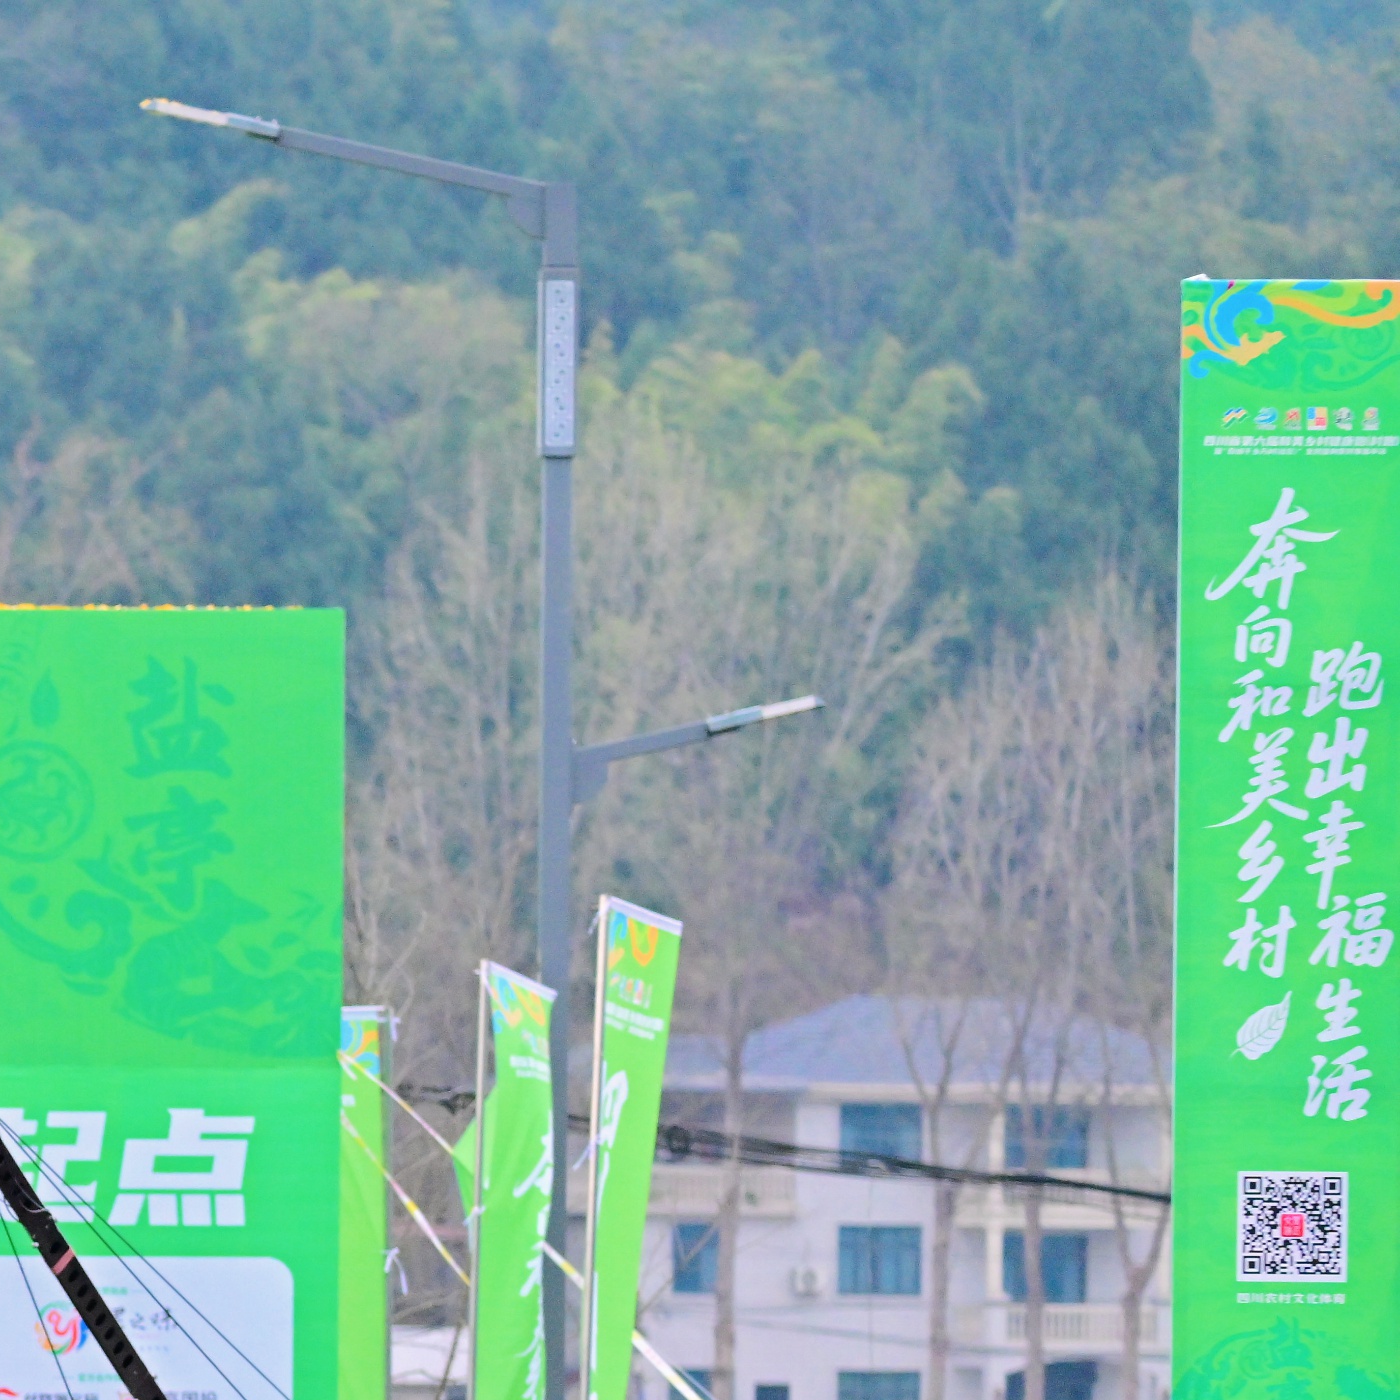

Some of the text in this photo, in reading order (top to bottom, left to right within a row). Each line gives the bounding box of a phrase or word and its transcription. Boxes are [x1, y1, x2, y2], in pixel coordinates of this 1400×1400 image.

[1203, 487, 1341, 978] 奔向和美乡村
[1302, 640, 1396, 1121] 跑出幸福生活
